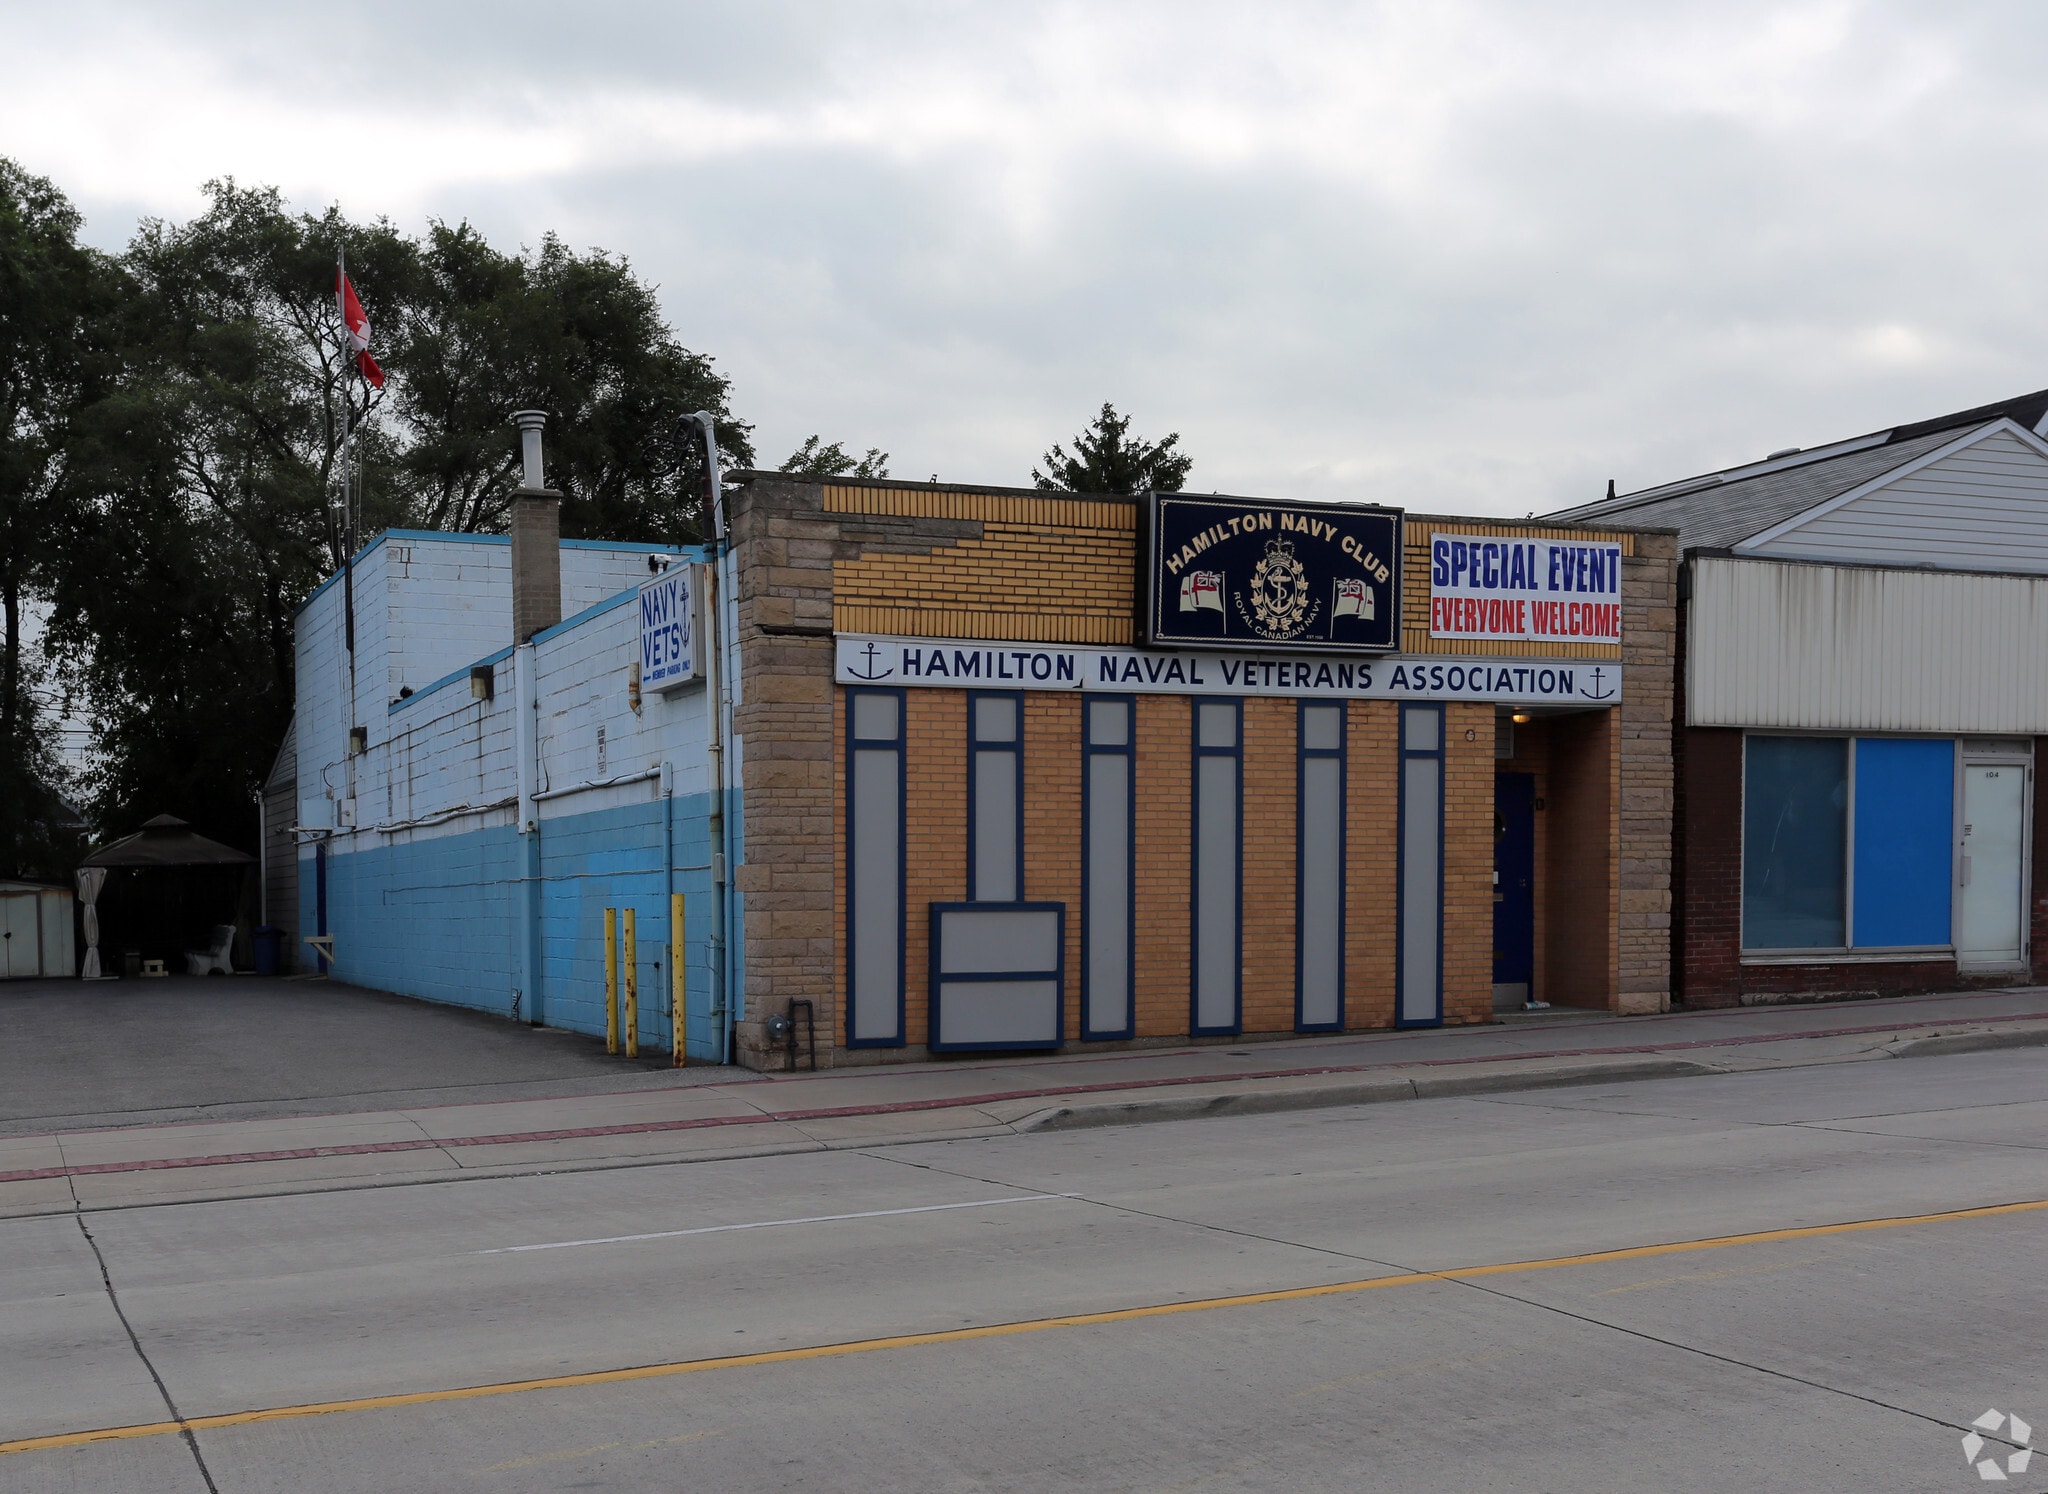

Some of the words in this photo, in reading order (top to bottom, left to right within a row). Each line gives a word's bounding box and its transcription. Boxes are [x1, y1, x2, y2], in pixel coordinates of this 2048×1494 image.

[1166, 513, 1273, 575] HAMILTON
[1281, 512, 1338, 542] NAVY
[1341, 535, 1390, 583] CLUB
[1433, 540, 1538, 590] SPECIAL
[1548, 546, 1620, 593] EVENT
[642, 580, 677, 629] NAVY
[1233, 591, 1253, 628] ROYAL
[1254, 624, 1305, 640] CANADIAN
[1304, 598, 1322, 627] NAVY
[1432, 597, 1526, 634] EVERYONE
[1531, 601, 1620, 638] WELCOME
[643, 622, 680, 669] VETS
[902, 648, 1075, 682] HAMILTON
[1100, 655, 1204, 685] NAVAL
[1220, 659, 1373, 690] VETERANS
[1389, 665, 1574, 695] ASSOCIATION
